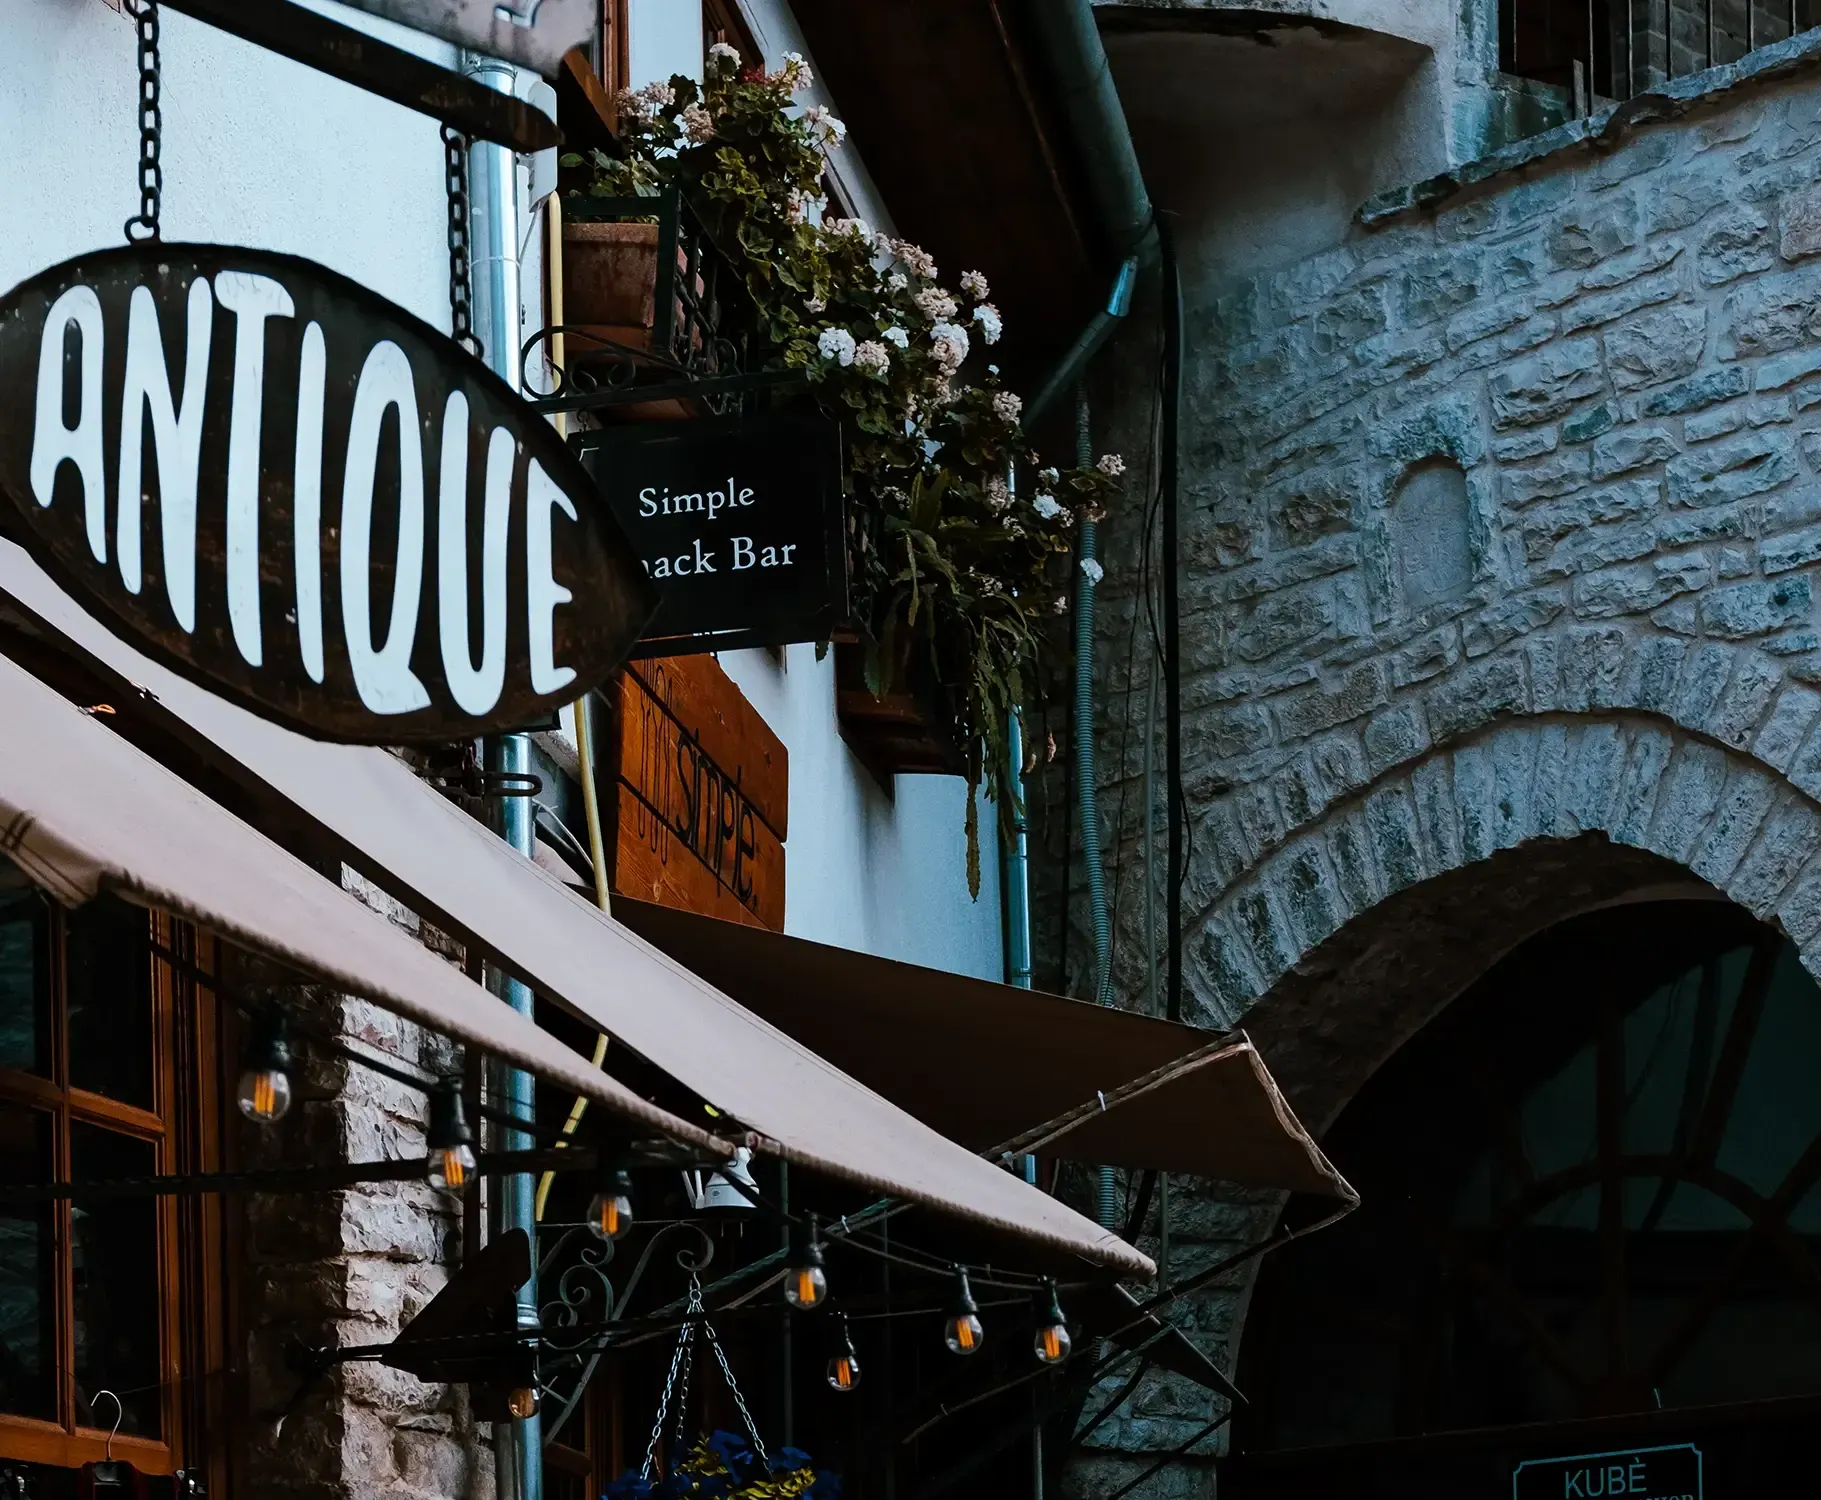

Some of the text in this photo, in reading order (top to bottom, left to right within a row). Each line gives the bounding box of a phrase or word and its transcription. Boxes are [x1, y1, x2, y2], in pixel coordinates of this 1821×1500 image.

[30, 270, 577, 715] ANTIQUE
[639, 477, 755, 520] Simple
[730, 536, 797, 571] Bar
